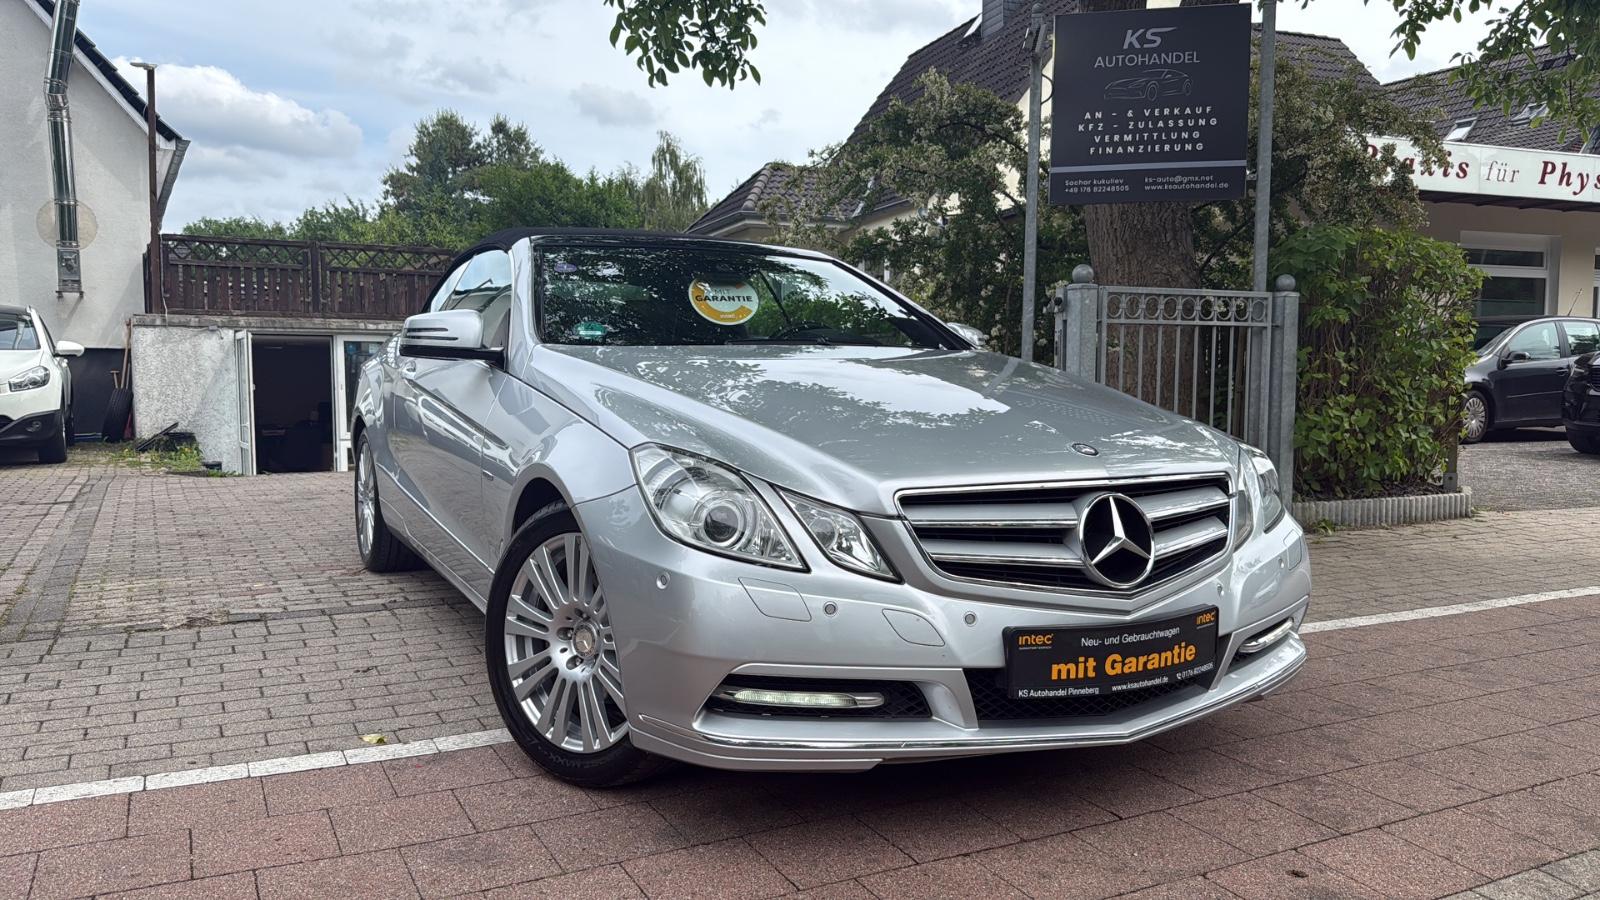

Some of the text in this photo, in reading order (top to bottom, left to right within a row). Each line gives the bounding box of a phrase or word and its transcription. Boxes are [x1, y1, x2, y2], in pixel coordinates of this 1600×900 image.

[1123, 27, 1177, 49] KS
[1094, 51, 1200, 68] AUTOHANDEL
[1084, 111, 1102, 119] AN
[1144, 106, 1213, 116] VERKAUF
[1078, 123, 1104, 132] KFZ
[1128, 118, 1218, 129] ZULASSUNG
[1094, 131, 1200, 143] VERMITTLUNG
[1089, 143, 1204, 155] FINANZIERUNG
[1484, 160, 1520, 183] für
[1144, 182, 1229, 191] www.ksautohandel.de
[1081, 626, 1180, 647] Neu- und Gebrauchtwagen
[1051, 641, 1196, 680] mit Garantie
[1112, 676, 1169, 691] www.ksautohandel.de
[1018, 686, 1099, 698] KS Autohandel Pinneberg
